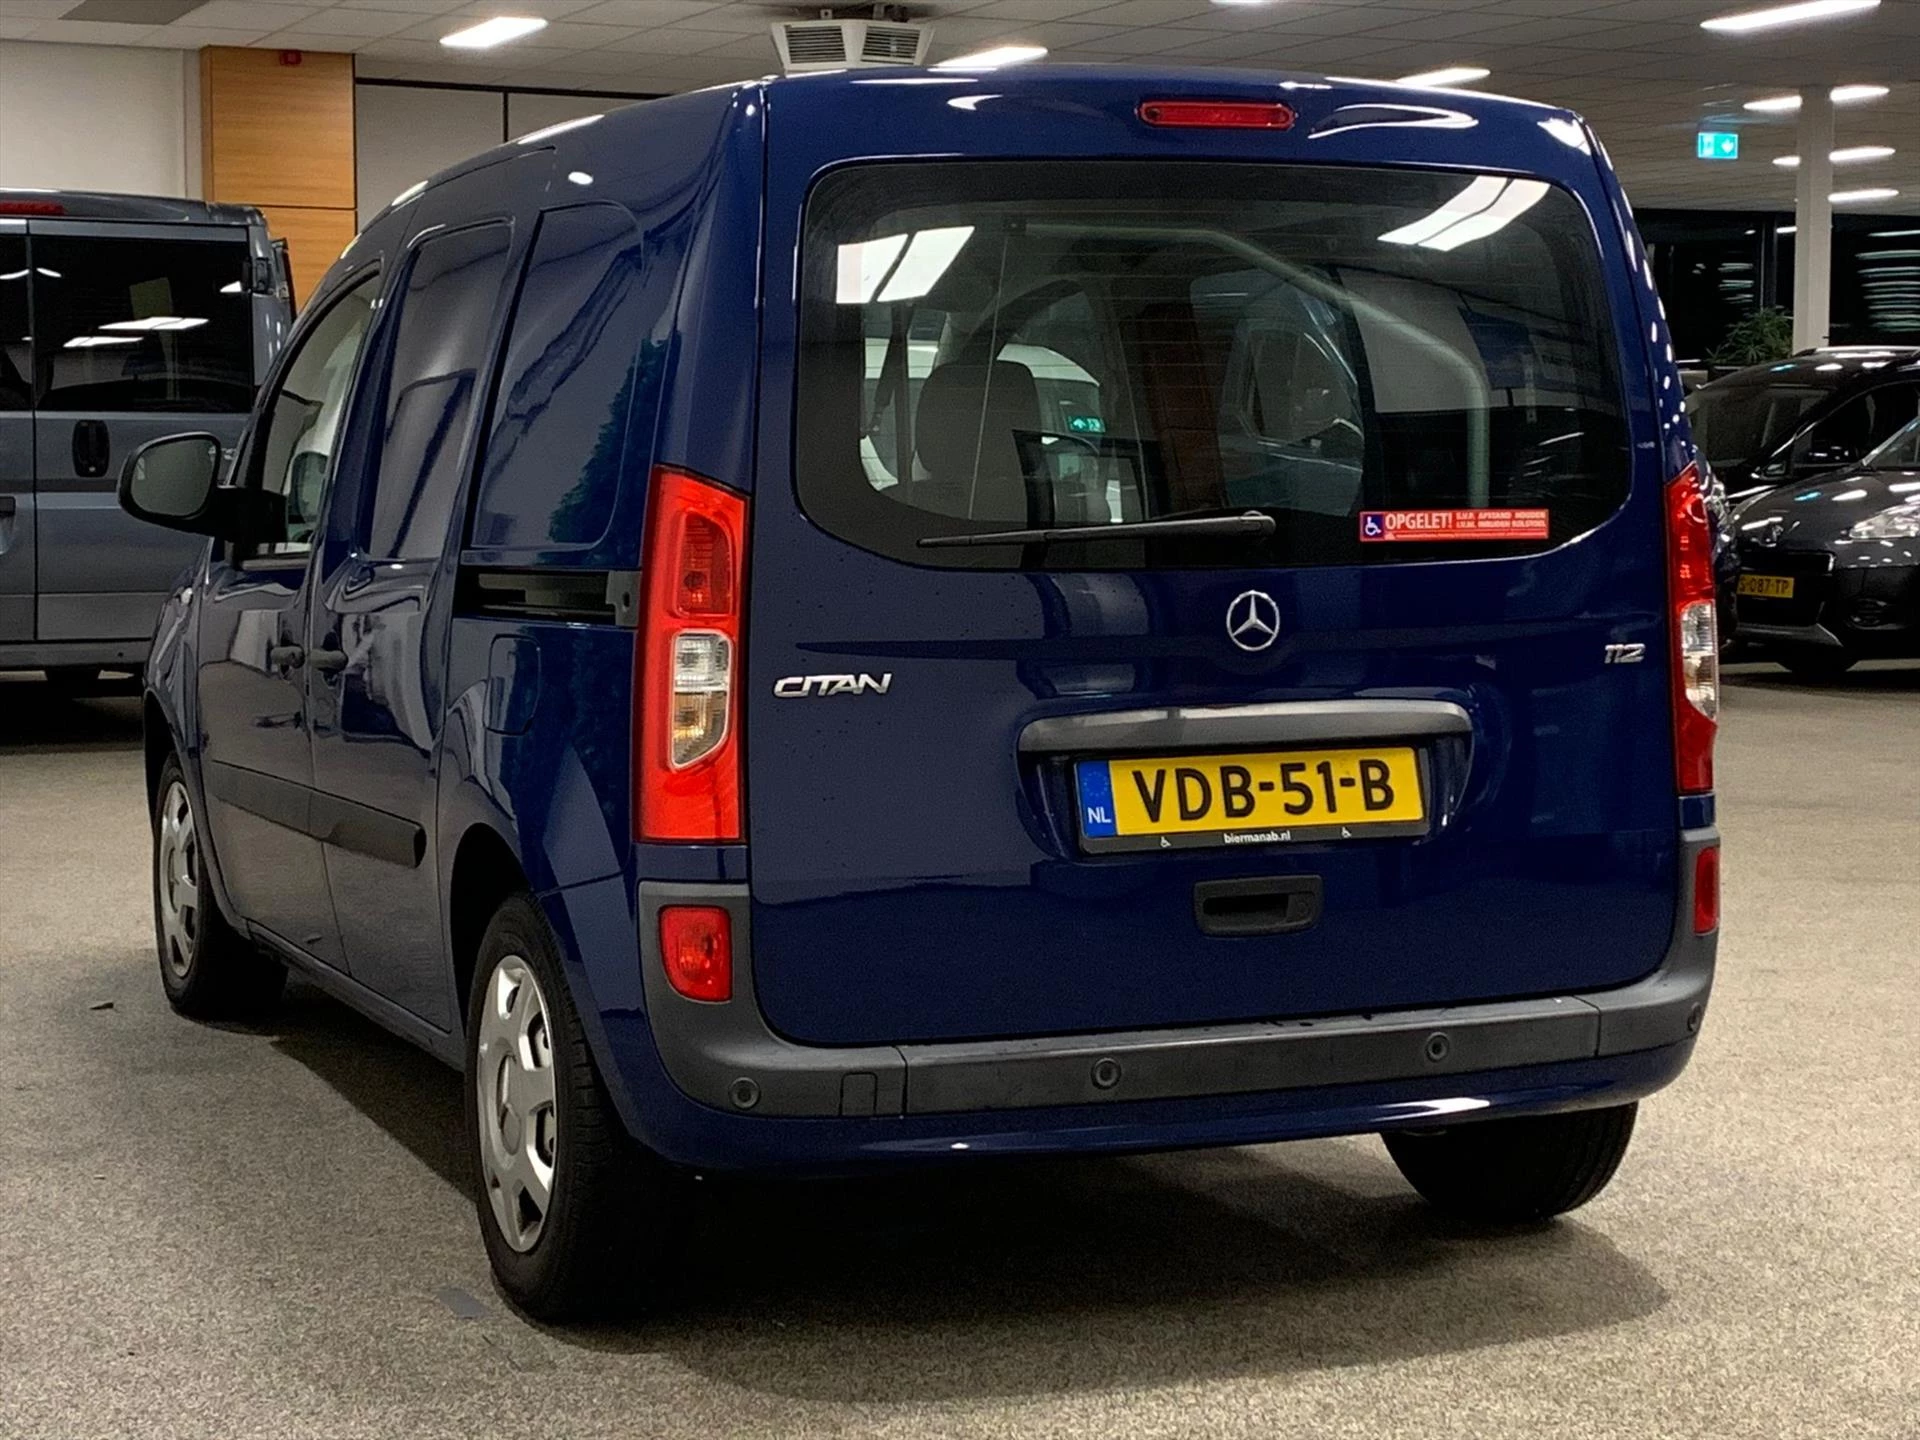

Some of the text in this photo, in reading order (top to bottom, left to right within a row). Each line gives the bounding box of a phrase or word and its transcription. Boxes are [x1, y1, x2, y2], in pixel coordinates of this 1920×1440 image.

[1384, 512, 1453, 530] OPGELET!
[1603, 642, 1646, 664] 112
[774, 672, 893, 698] CITAN
[1131, 758, 1396, 823] VDB-51-B
[1087, 806, 1112, 825] NL
[1223, 830, 1292, 845] biermanab.nl
